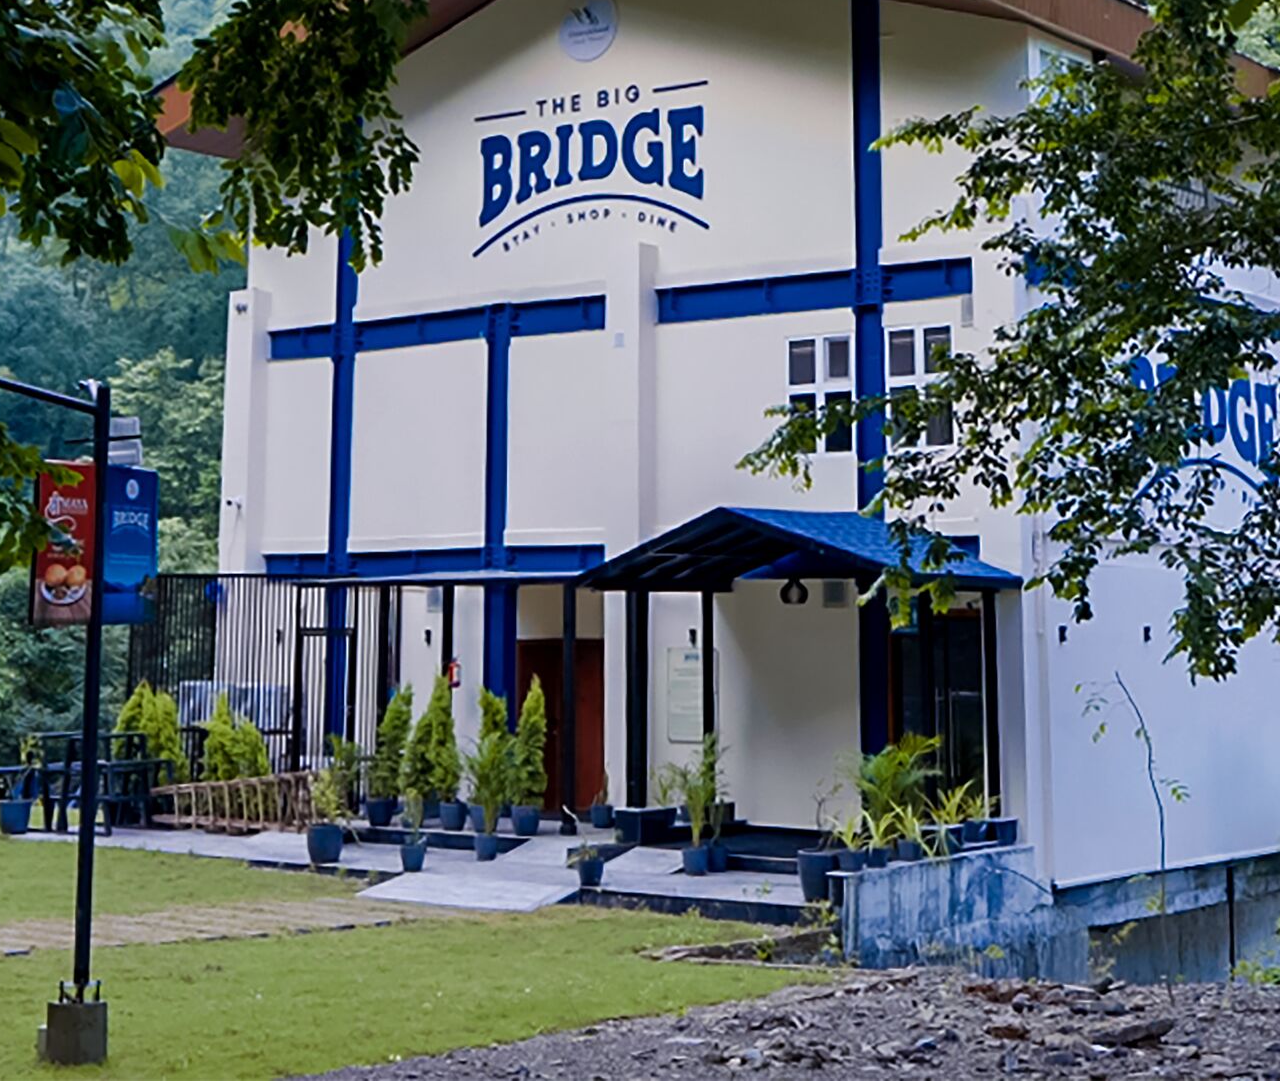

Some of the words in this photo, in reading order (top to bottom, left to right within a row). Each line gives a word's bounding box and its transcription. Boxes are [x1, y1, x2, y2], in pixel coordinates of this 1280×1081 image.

[536, 94, 582, 117] THE
[597, 84, 641, 108] BIG
[479, 105, 704, 228] BRIDGE
[502, 224, 542, 252] STAY
[566, 208, 612, 224] SHOP
[638, 210, 679, 233] DINE
[1130, 355, 1278, 478] DGE
